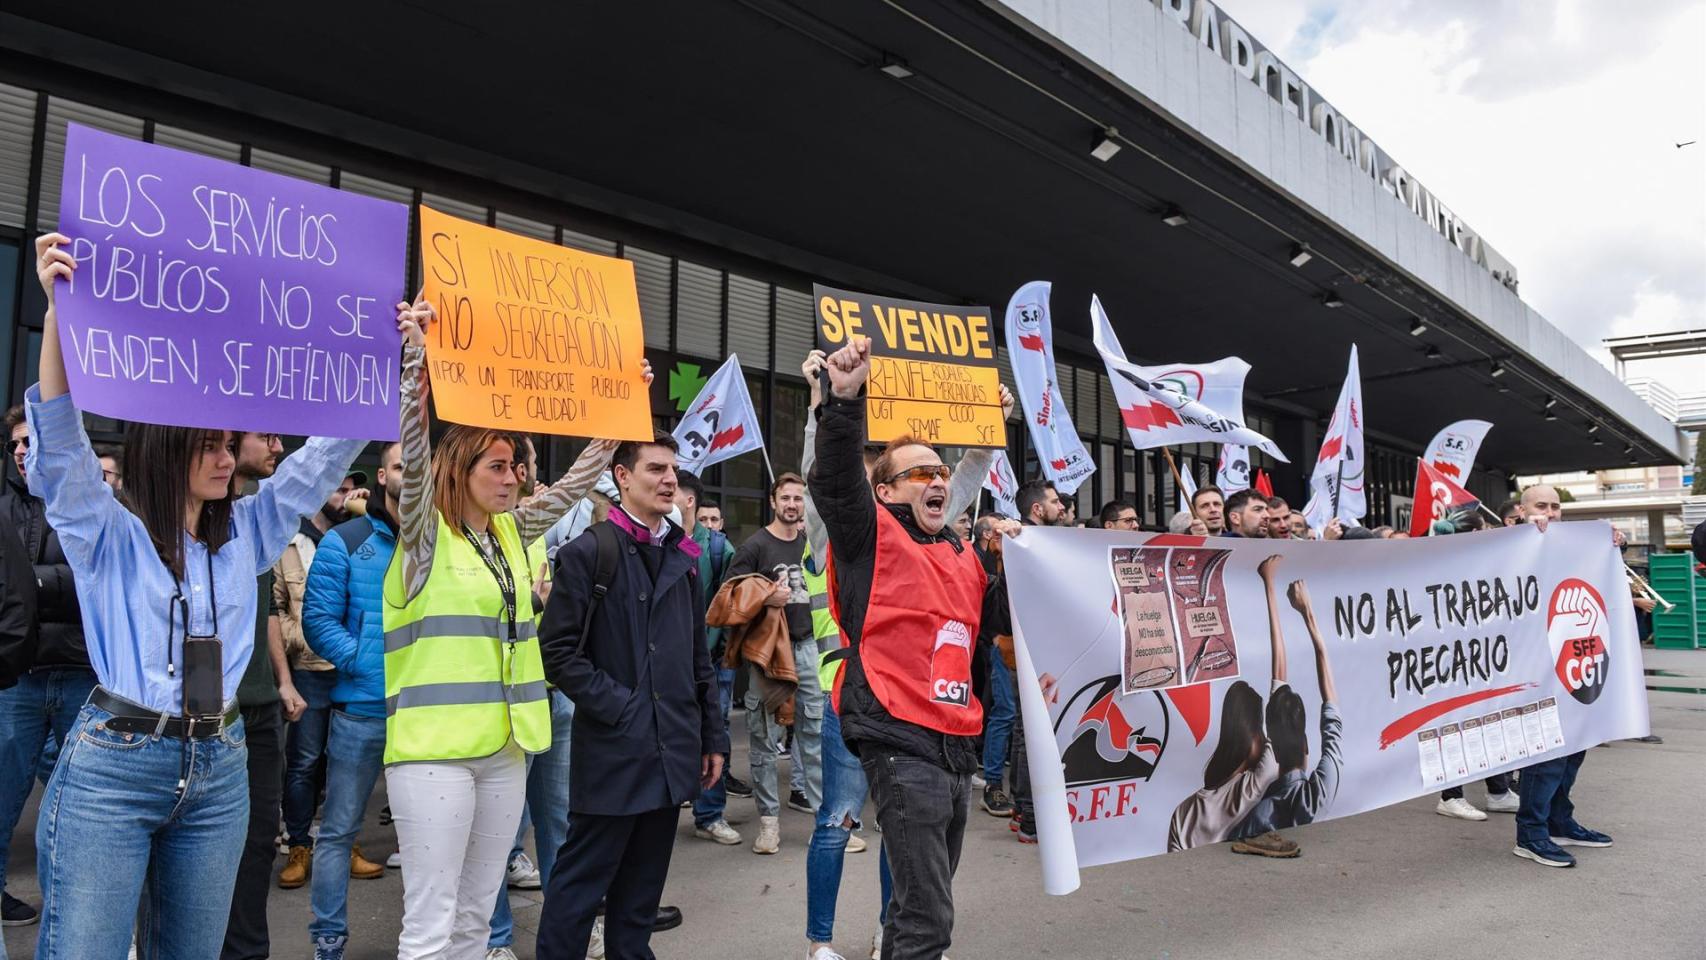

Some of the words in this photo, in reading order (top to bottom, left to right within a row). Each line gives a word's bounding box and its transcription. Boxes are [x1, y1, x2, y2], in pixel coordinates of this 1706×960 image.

[79, 153, 165, 237] LOS
[186, 185, 337, 266] SERVICIOS
[70, 233, 229, 313] PÚBLICOS
[260, 277, 311, 330] NO
[329, 294, 376, 339] SE
[438, 292, 474, 351] NO
[820, 296, 866, 343] SE
[872, 304, 993, 359] VENDE
[69, 323, 209, 395] VENDEN,
[219, 340, 254, 395] SE
[265, 342, 391, 406] DEFIENDEN
[869, 356, 934, 400] RENFE
[478, 366, 496, 387] UN
[509, 368, 575, 394] TRANSPORTE
[491, 393, 513, 420] DE
[870, 399, 895, 420] UGT
[948, 405, 975, 424] CCOO
[906, 418, 943, 441] SEMAF
[976, 424, 996, 445] SCF
[1445, 437, 1465, 451] S.F.
[1119, 566, 1143, 576] HUELGA
[1144, 609, 1162, 623] huelga
[1191, 611, 1217, 623] HUELGA
[1334, 592, 1376, 639] NO
[1386, 587, 1422, 637] AL
[1426, 574, 1540, 630] TRABAJO
[1135, 645, 1174, 658] desconvocada
[1573, 638, 1597, 658] SFF
[1387, 634, 1509, 699] PRECARIO
[1565, 653, 1605, 690] CGT
[933, 678, 969, 702] CGT
[1065, 782, 1138, 824] S.F.F.
